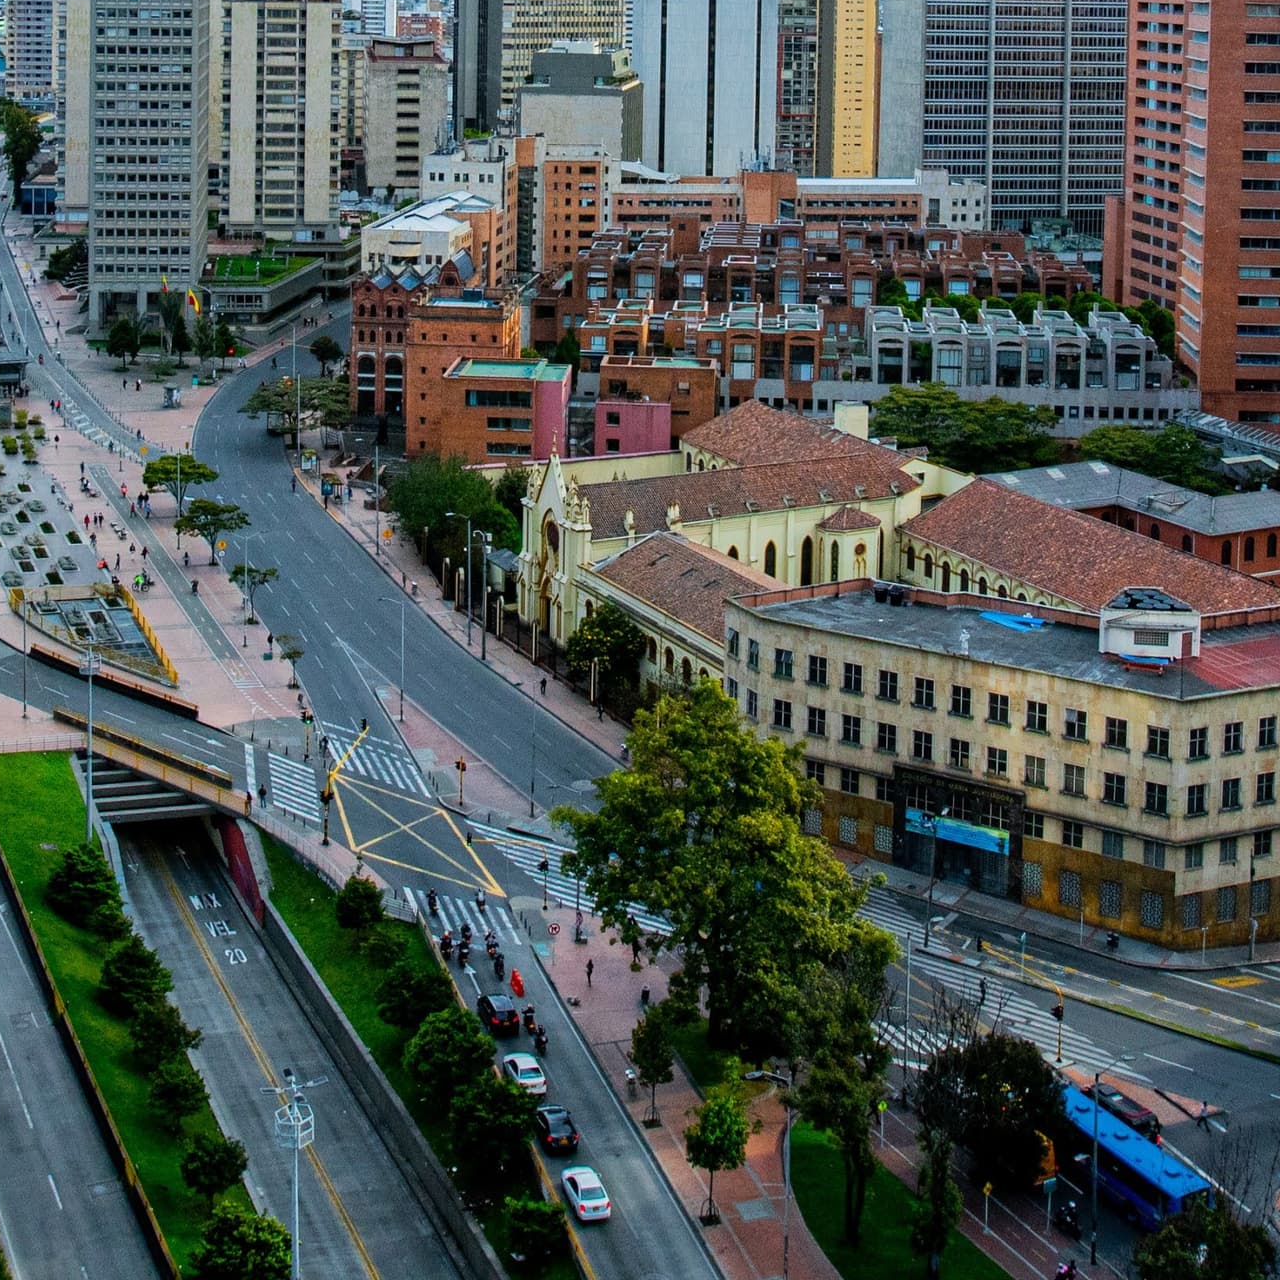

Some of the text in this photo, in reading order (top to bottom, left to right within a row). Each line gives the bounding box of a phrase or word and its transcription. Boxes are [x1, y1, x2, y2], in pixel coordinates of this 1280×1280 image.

[189, 892, 222, 910] MAX
[204, 920, 237, 937] VEL
[224, 948, 248, 965] 20
